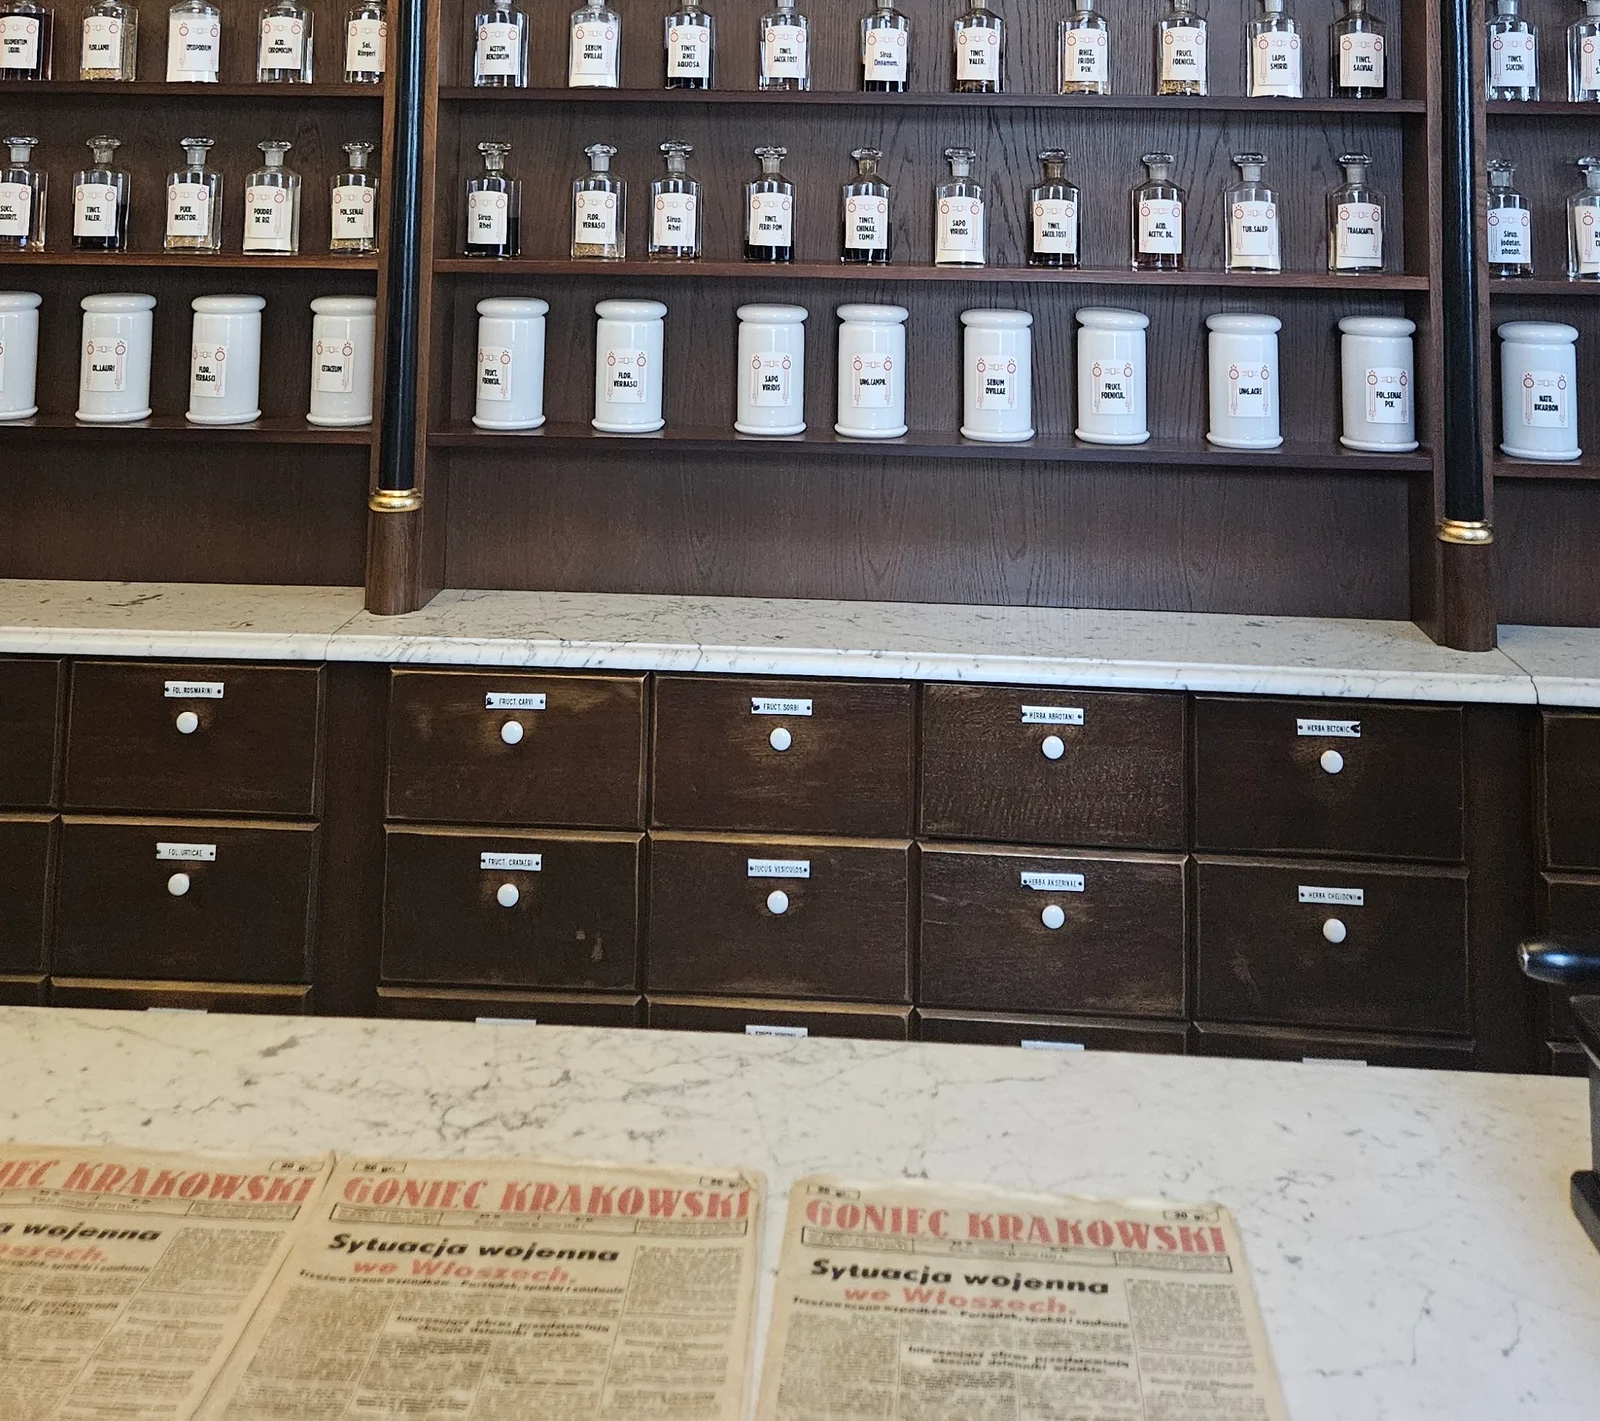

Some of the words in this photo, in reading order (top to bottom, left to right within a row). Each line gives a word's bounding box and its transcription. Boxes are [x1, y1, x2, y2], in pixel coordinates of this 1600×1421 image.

[63, 1162, 316, 1204] KRAKOWSKI
[343, 1177, 488, 1210] GONIEC
[500, 1181, 750, 1219] KRAKOWSKI
[23, 1220, 163, 1242] wojenna
[806, 1198, 949, 1239] GONIEC
[967, 1210, 1226, 1252] KRAKOWSKI
[328, 1232, 469, 1258] Sytuacja
[478, 1241, 620, 1263] wojenna
[353, 1260, 398, 1274] we
[810, 1258, 952, 1285] Sytuacja
[963, 1272, 1109, 1294] wojenna
[844, 1287, 890, 1301] we
